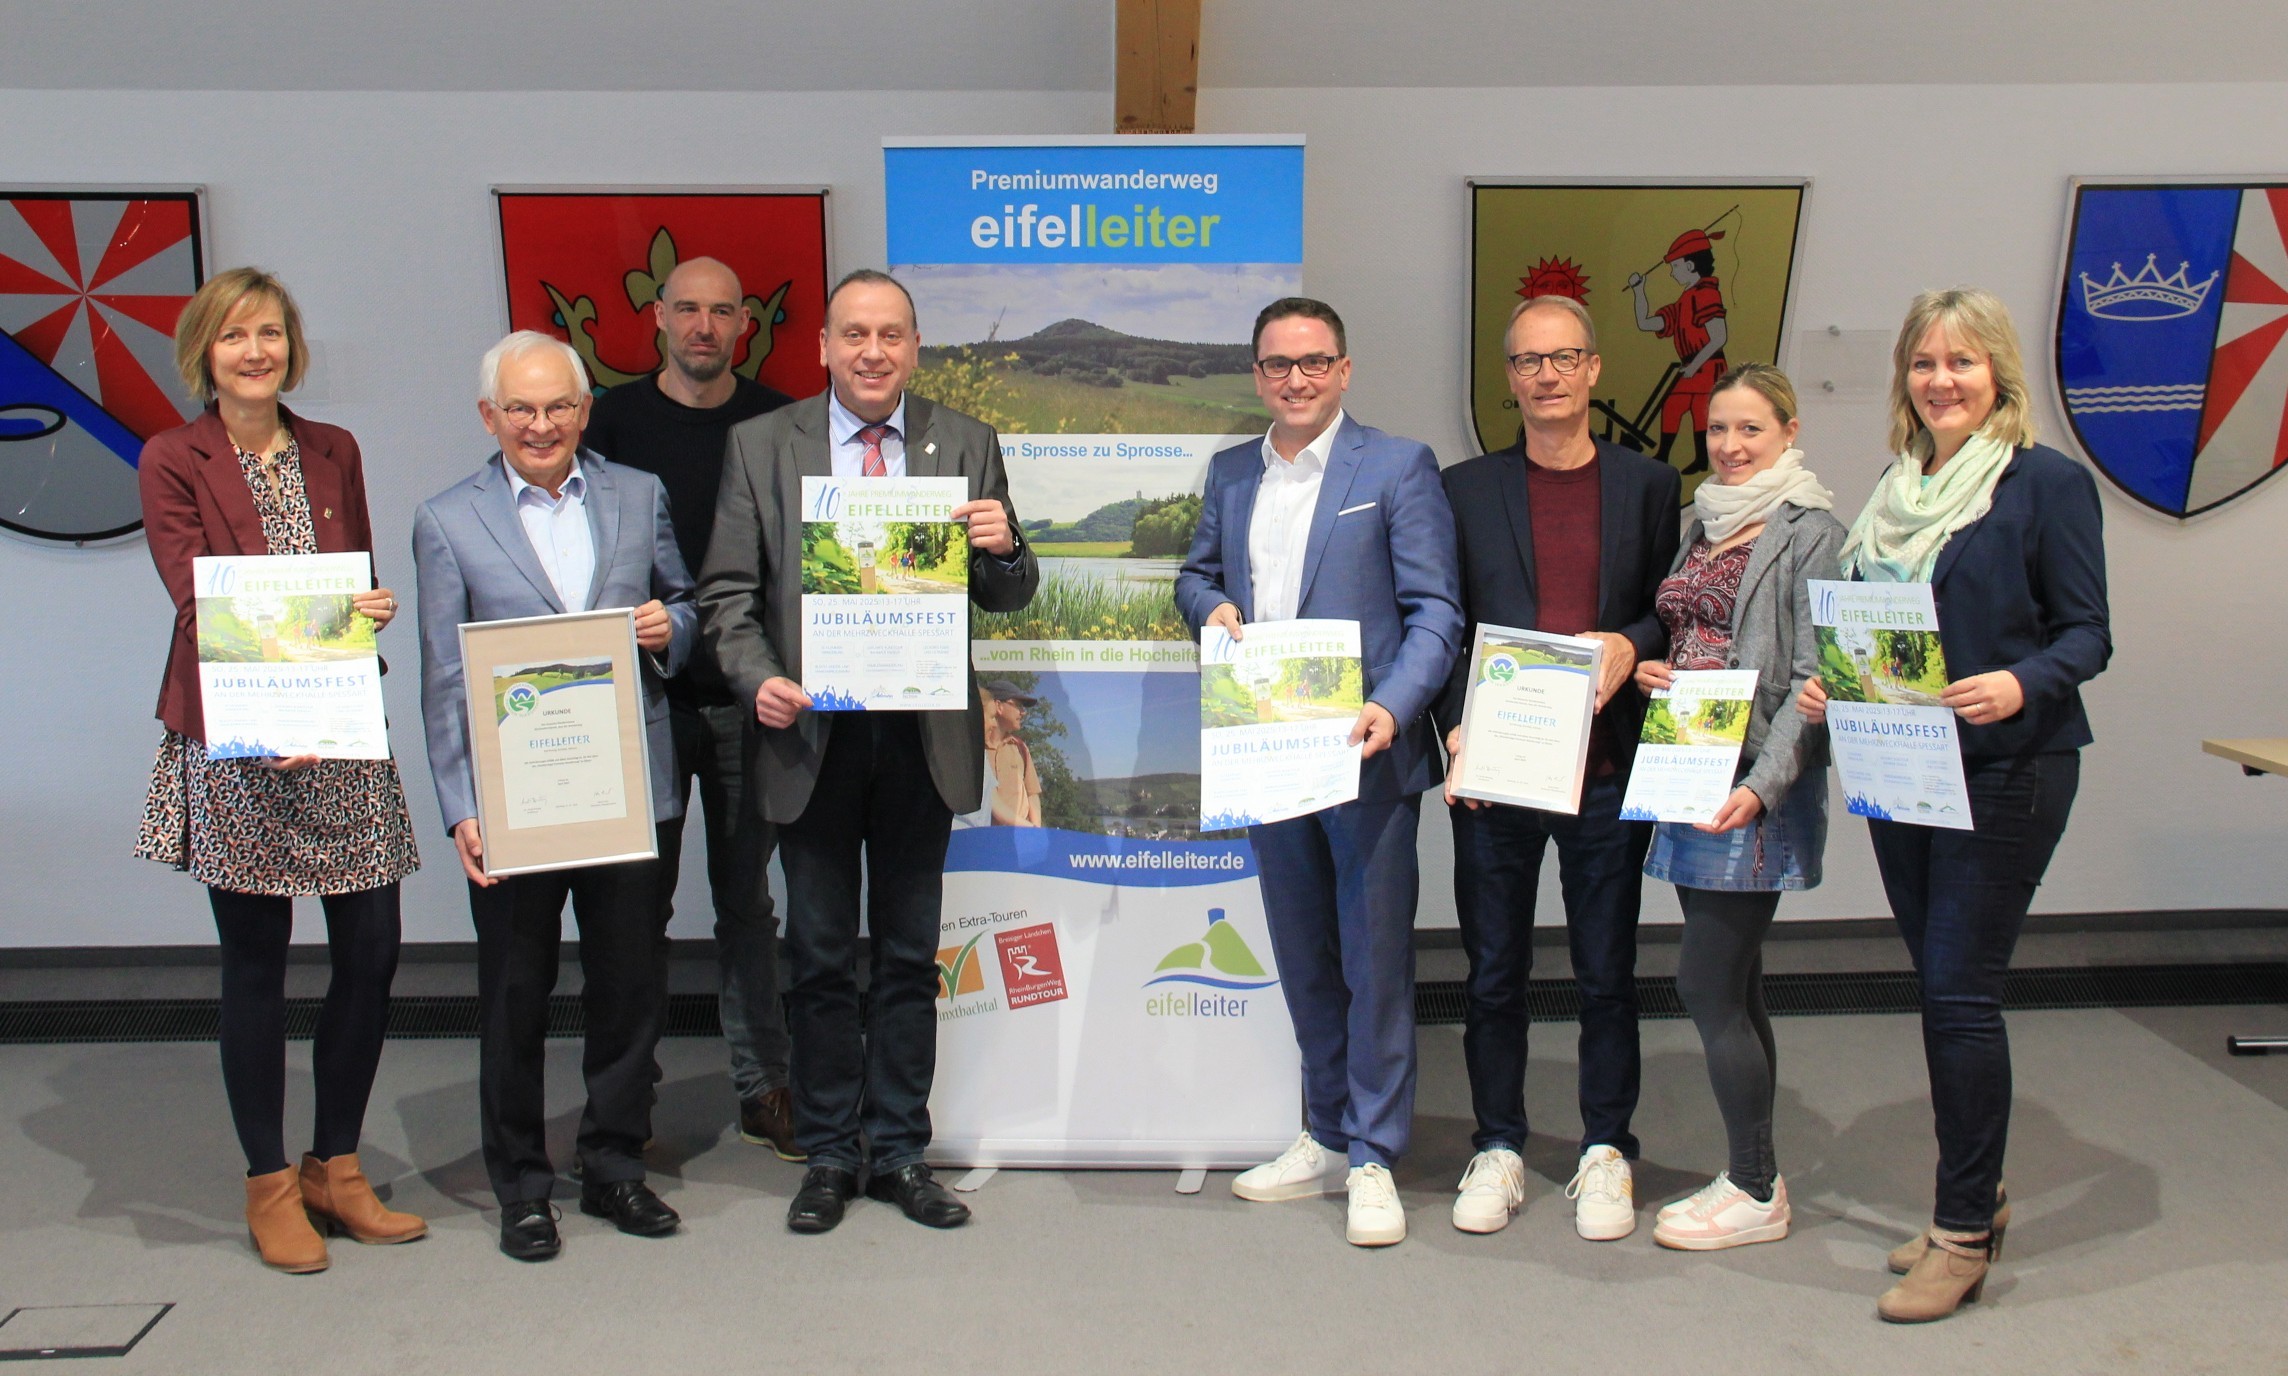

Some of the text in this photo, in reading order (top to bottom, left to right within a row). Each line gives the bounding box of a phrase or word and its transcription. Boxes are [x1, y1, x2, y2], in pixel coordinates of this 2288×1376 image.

[971, 169, 1219, 194] Premiumwanderweg
[971, 204, 1220, 248] eifelleiter
[1000, 442, 1193, 460] on Sprosse zu Sprosse...
[814, 483, 840, 520] 10
[848, 504, 952, 517] EIFELLEITER
[208, 562, 236, 595] 10
[244, 577, 356, 592] EIFELLEITER
[1819, 586, 1835, 624] 10
[813, 610, 956, 624] JUBILÄUMSFEST
[1841, 609, 1924, 625] EIFELLEITER
[980, 648, 1200, 661] ...vom Rhein in die Hocheife
[1244, 641, 1345, 659] EIFELLEITER
[213, 674, 367, 689] JUBILÄUMSFEST
[1517, 686, 1545, 694] URKUNDE
[1679, 687, 1745, 696] EIFELLEITER
[542, 709, 572, 717] URKUNDE
[1497, 710, 1557, 727] EIFELLEITER
[1835, 718, 1948, 739] JUBILÄUMSFEST
[530, 735, 591, 749] EIFELLEITER
[1211, 734, 1350, 756] JUBILÄUMSFEST
[1641, 755, 1730, 766] JUBILÄUMSFEST
[1069, 851, 1244, 870] www.eifelleiter.de
[959, 909, 1028, 929] Extra-Touren
[1024, 928, 1051, 940] Ländchen
[1011, 987, 1064, 1005] RUNDTOUR
[1146, 992, 1248, 1017] eifelleiter
[938, 998, 998, 1021] inxtbachtal
